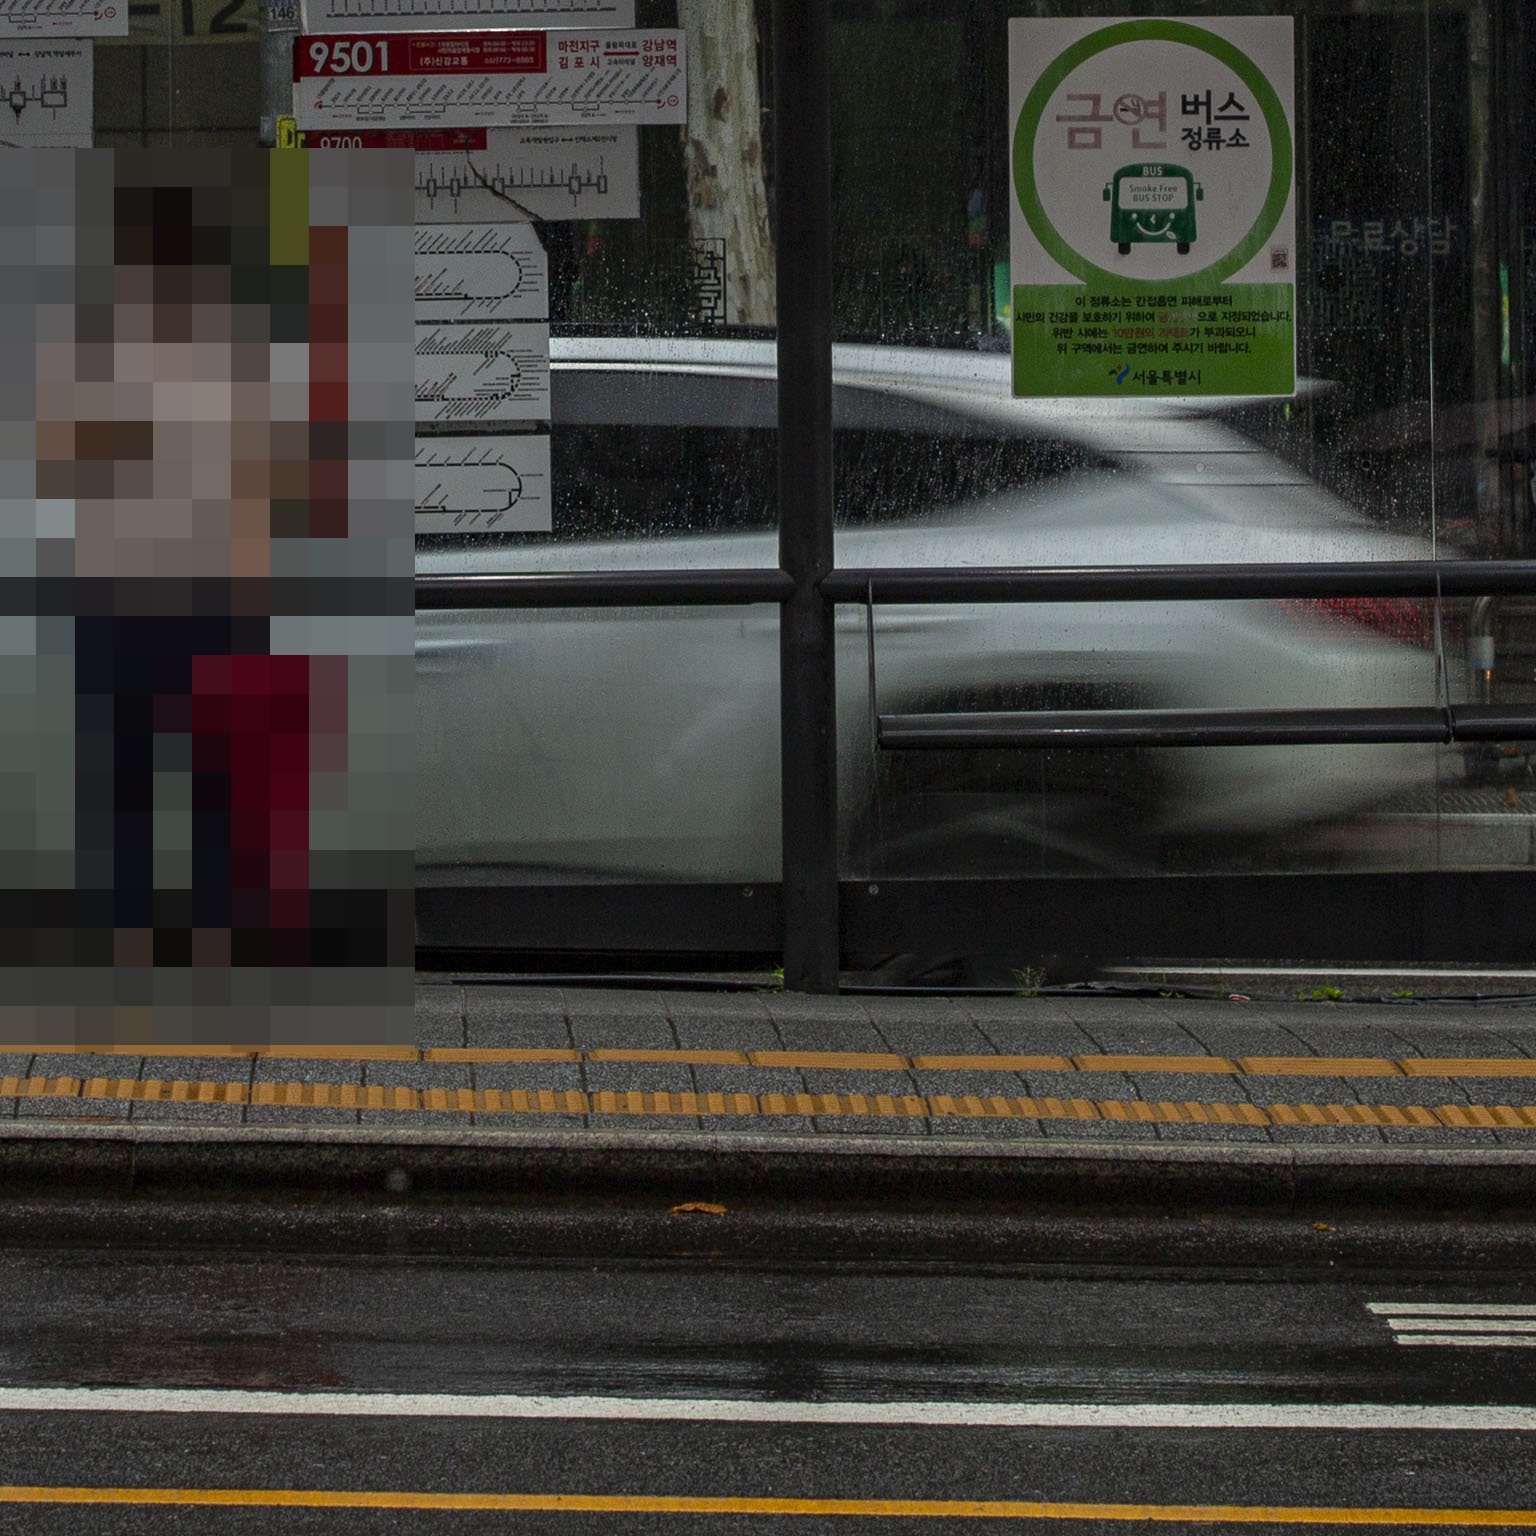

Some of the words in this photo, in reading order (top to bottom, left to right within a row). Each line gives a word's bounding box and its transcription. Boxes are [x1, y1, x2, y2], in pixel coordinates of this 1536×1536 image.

[558, 39, 600, 53] 마전지구
[642, 39, 677, 52] 강남역
[308, 40, 390, 73] 9501
[642, 54, 677, 68] 양재역
[1056, 91, 1167, 150] 금연
[1181, 89, 1250, 125] 버스
[1181, 127, 1250, 151] 정류소
[1142, 166, 1163, 176] BUS
[1128, 184, 1156, 193] Smoke
[1159, 184, 1178, 193] Free
[1133, 194, 1150, 202] BUS
[1152, 193, 1174, 202] STOP
[1132, 368, 1202, 386] 서울특별시
